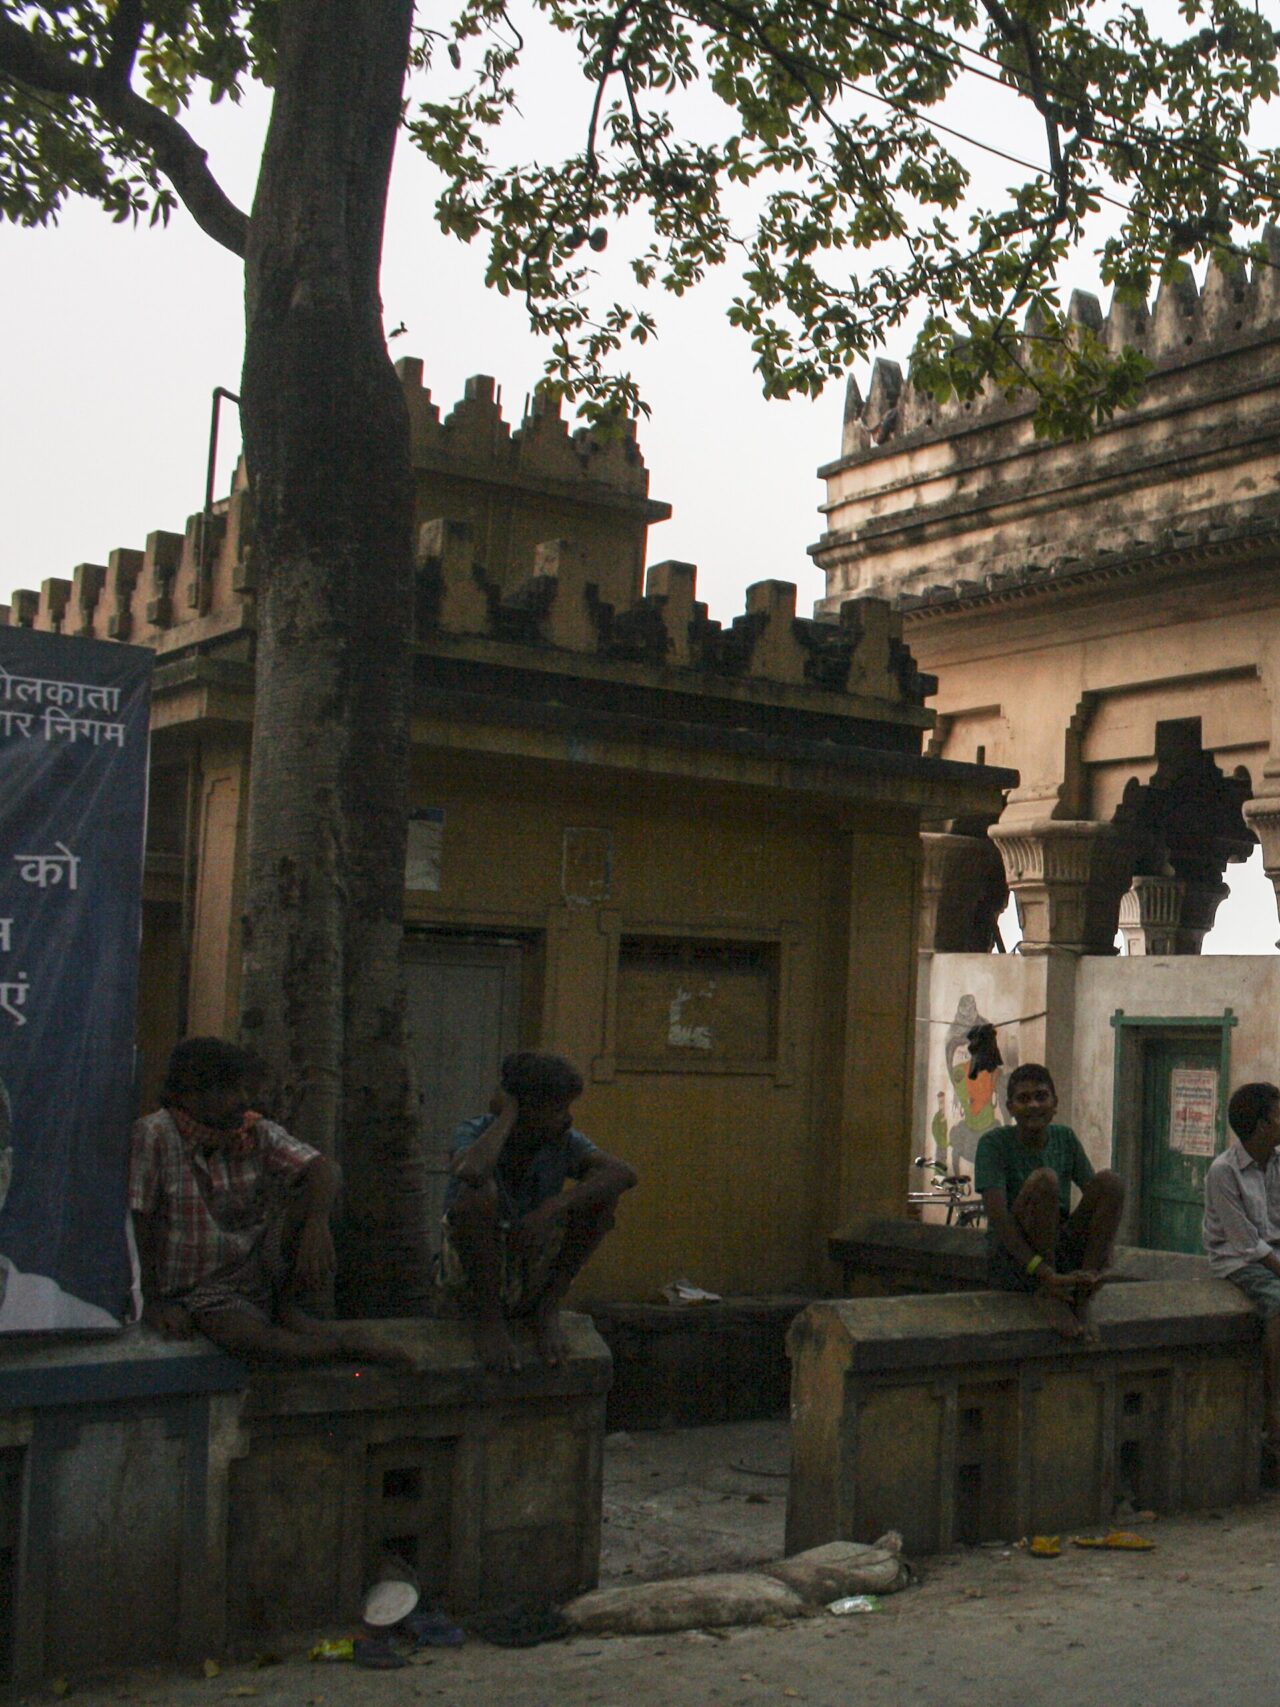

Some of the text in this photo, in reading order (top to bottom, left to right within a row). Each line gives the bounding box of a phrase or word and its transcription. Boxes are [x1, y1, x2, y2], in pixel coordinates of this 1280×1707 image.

[0, 668, 121, 711] ोलकाता
[41, 706, 126, 747] निगम
[14, 841, 80, 890] को
